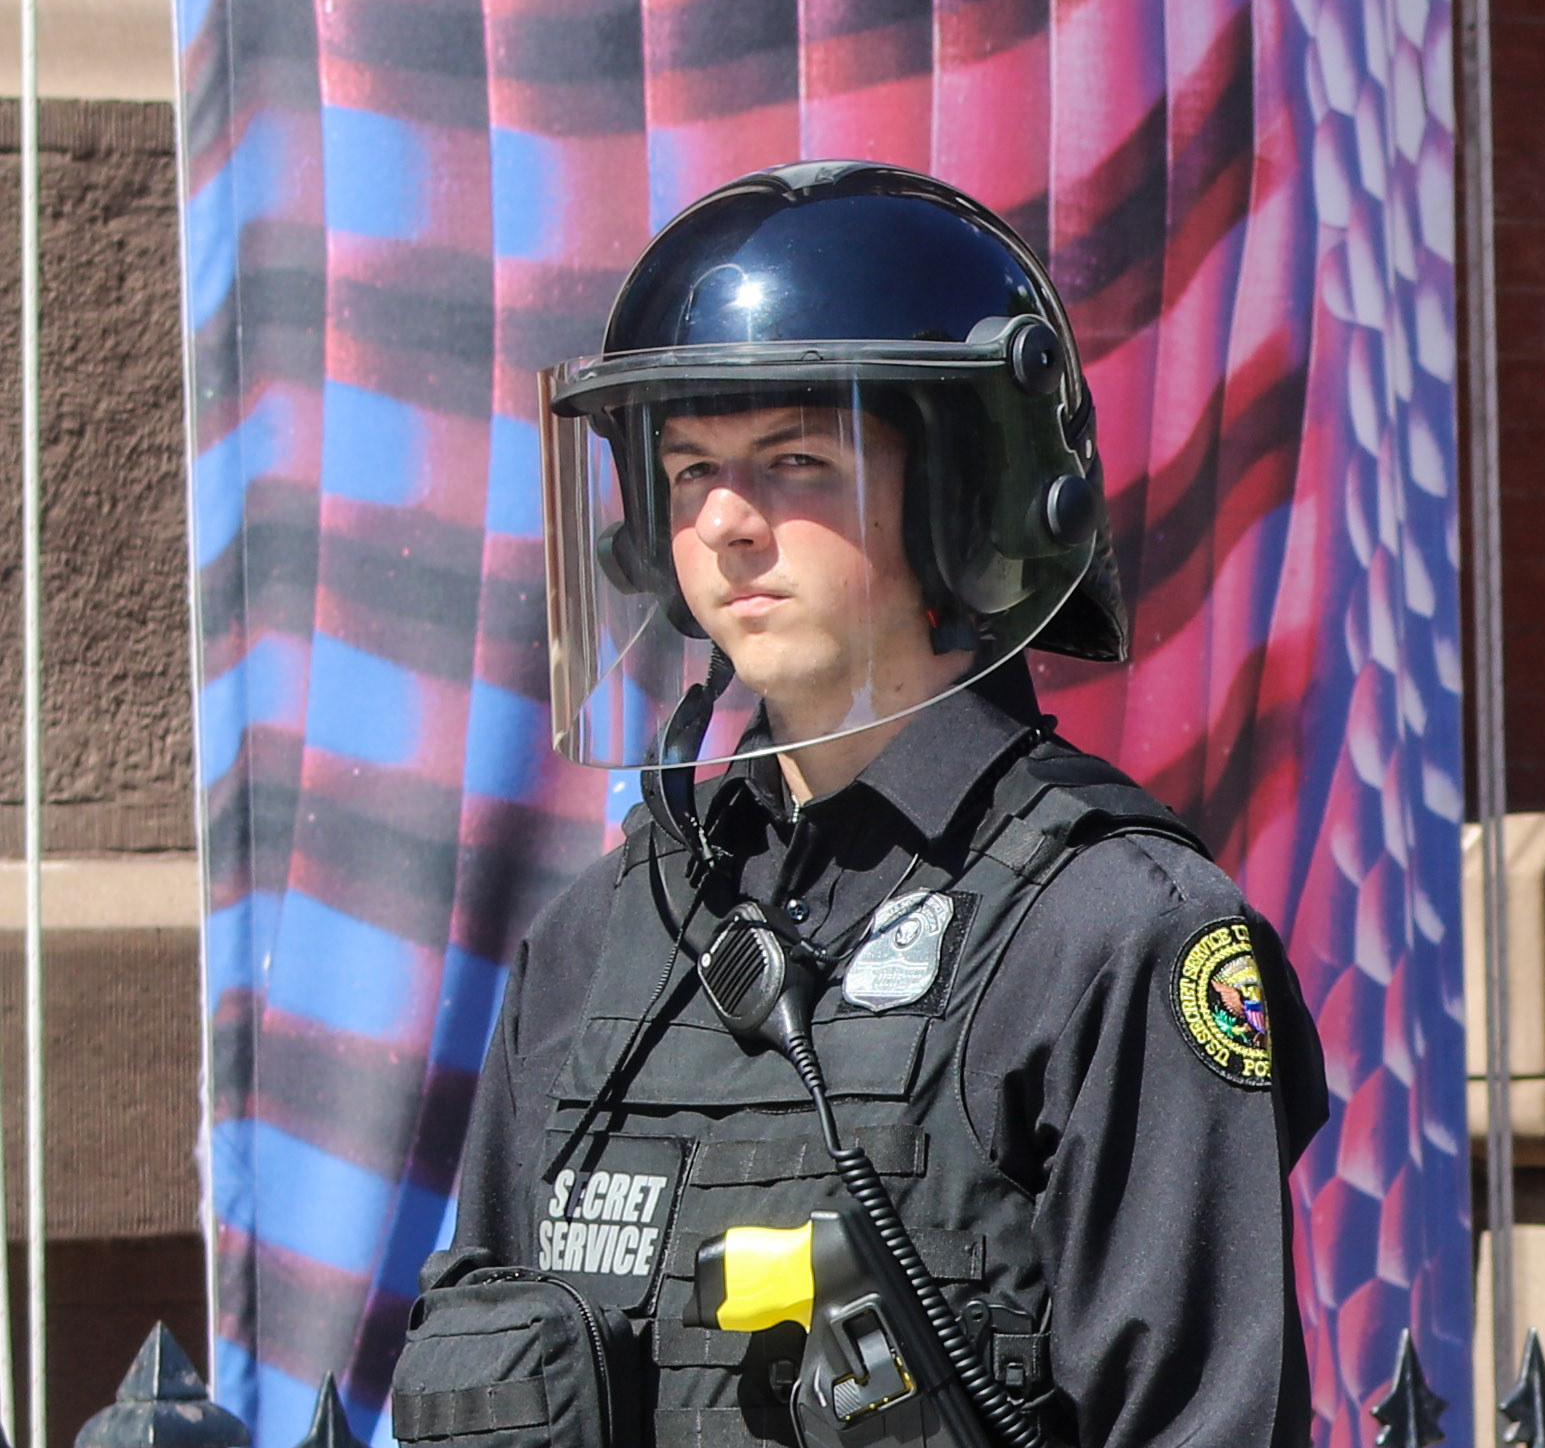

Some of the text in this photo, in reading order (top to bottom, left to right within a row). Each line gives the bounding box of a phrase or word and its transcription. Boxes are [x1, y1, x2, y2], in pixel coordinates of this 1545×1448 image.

[1183, 928, 1232, 979] SERVICE
[1180, 978, 1212, 1044] SECRET
[549, 1169, 667, 1223] SECRET
[539, 1220, 659, 1275] SERVICE
